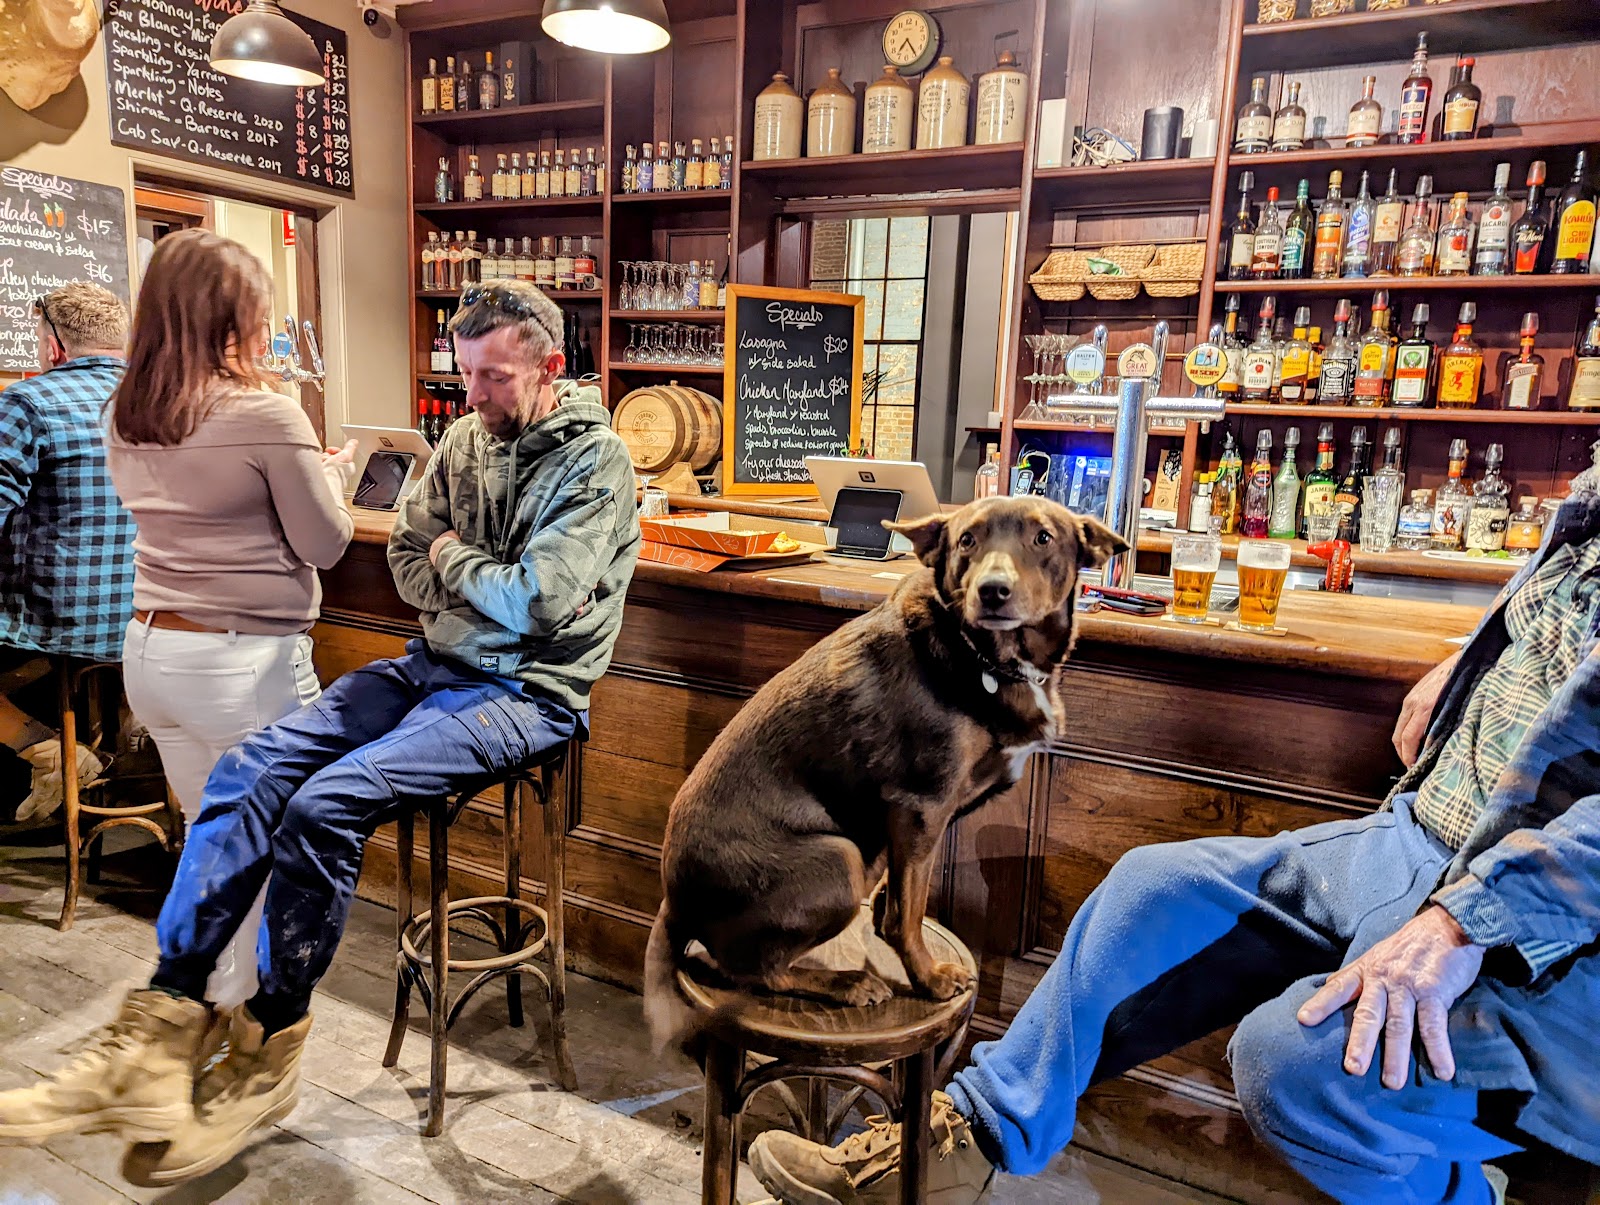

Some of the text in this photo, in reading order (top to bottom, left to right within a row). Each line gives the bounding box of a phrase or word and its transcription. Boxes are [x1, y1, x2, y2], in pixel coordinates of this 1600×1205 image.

[112, 21, 161, 53] Riesling
[139, 10, 182, 38] Blanc
[325, 40, 334, 52] B
[113, 59, 176, 94] Sparkling
[188, 78, 224, 102] Notes
[184, 60, 228, 84] Yarran
[115, 79, 164, 105] Merlot
[254, 114, 284, 132] 2020
[116, 98, 170, 122] Shiraz
[185, 115, 239, 142] Barossa
[246, 129, 279, 148] 2017
[118, 118, 146, 139] Cab
[0, 167, 73, 194] Specials
[77, 209, 114, 240] $15
[84, 260, 113, 283] $16
[765, 302, 824, 332] Specials
[739, 330, 848, 363] Lasagna $20
[786, 355, 816, 370] salad
[1126, 362, 1148, 370] GREAT
[1446, 360, 1474, 370] FIREBALL
[740, 374, 781, 400] Chicken
[783, 378, 831, 412] Maryland
[754, 404, 788, 424] Maryland
[800, 409, 830, 420] roasted
[758, 458, 774, 468] our
